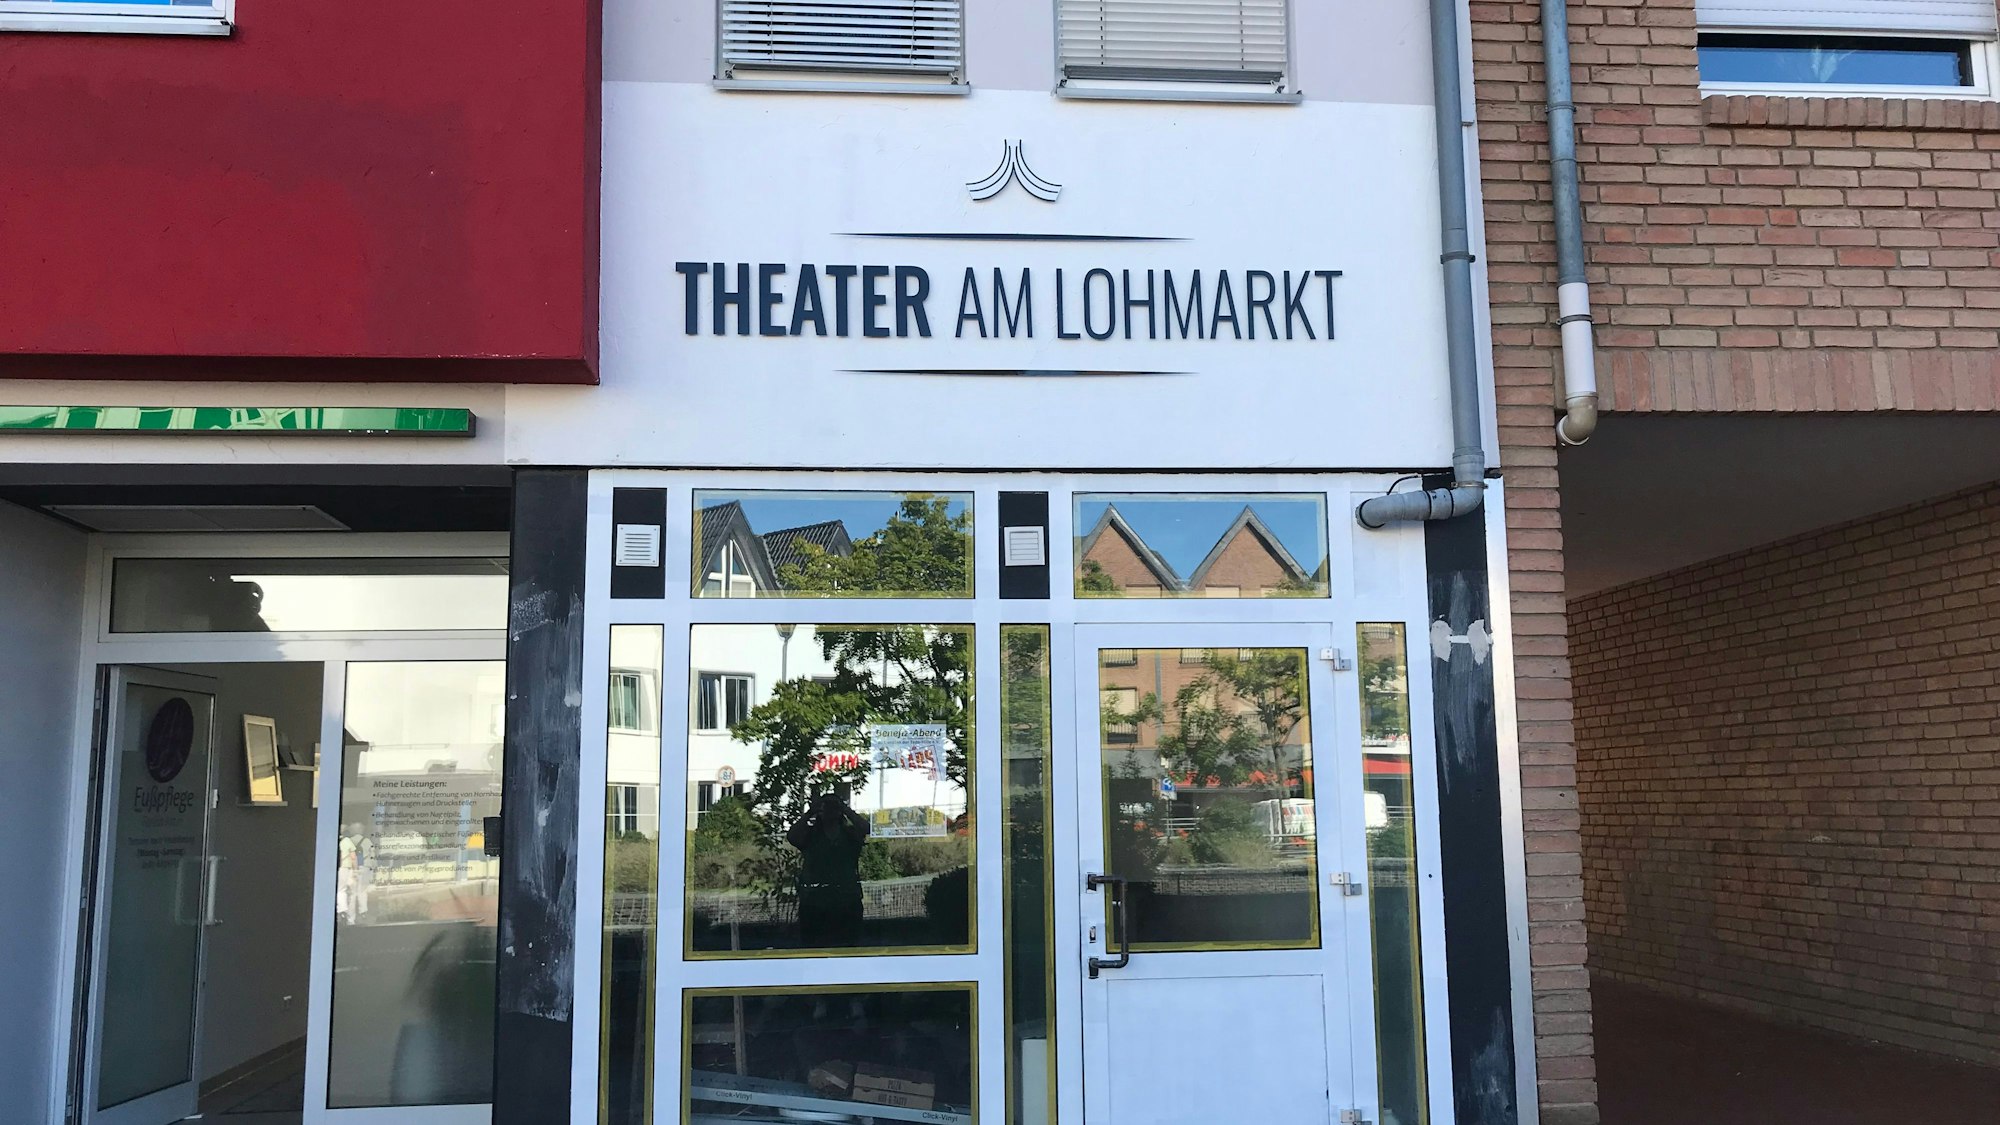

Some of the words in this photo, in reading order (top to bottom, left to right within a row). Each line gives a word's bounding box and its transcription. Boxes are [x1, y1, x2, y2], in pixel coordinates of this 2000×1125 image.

[675, 262, 932, 337] THEATER
[955, 267, 1033, 338] AM
[1056, 268, 1343, 340] LOHMARKT
[400, 780, 447, 789] Leistungen:
[134, 785, 194, 813] Fußpflege
[422, 791, 459, 799] Entfernung
[715, 1090, 753, 1101] Click-Vinyl
[922, 1111, 958, 1122] Click-Vinyl
